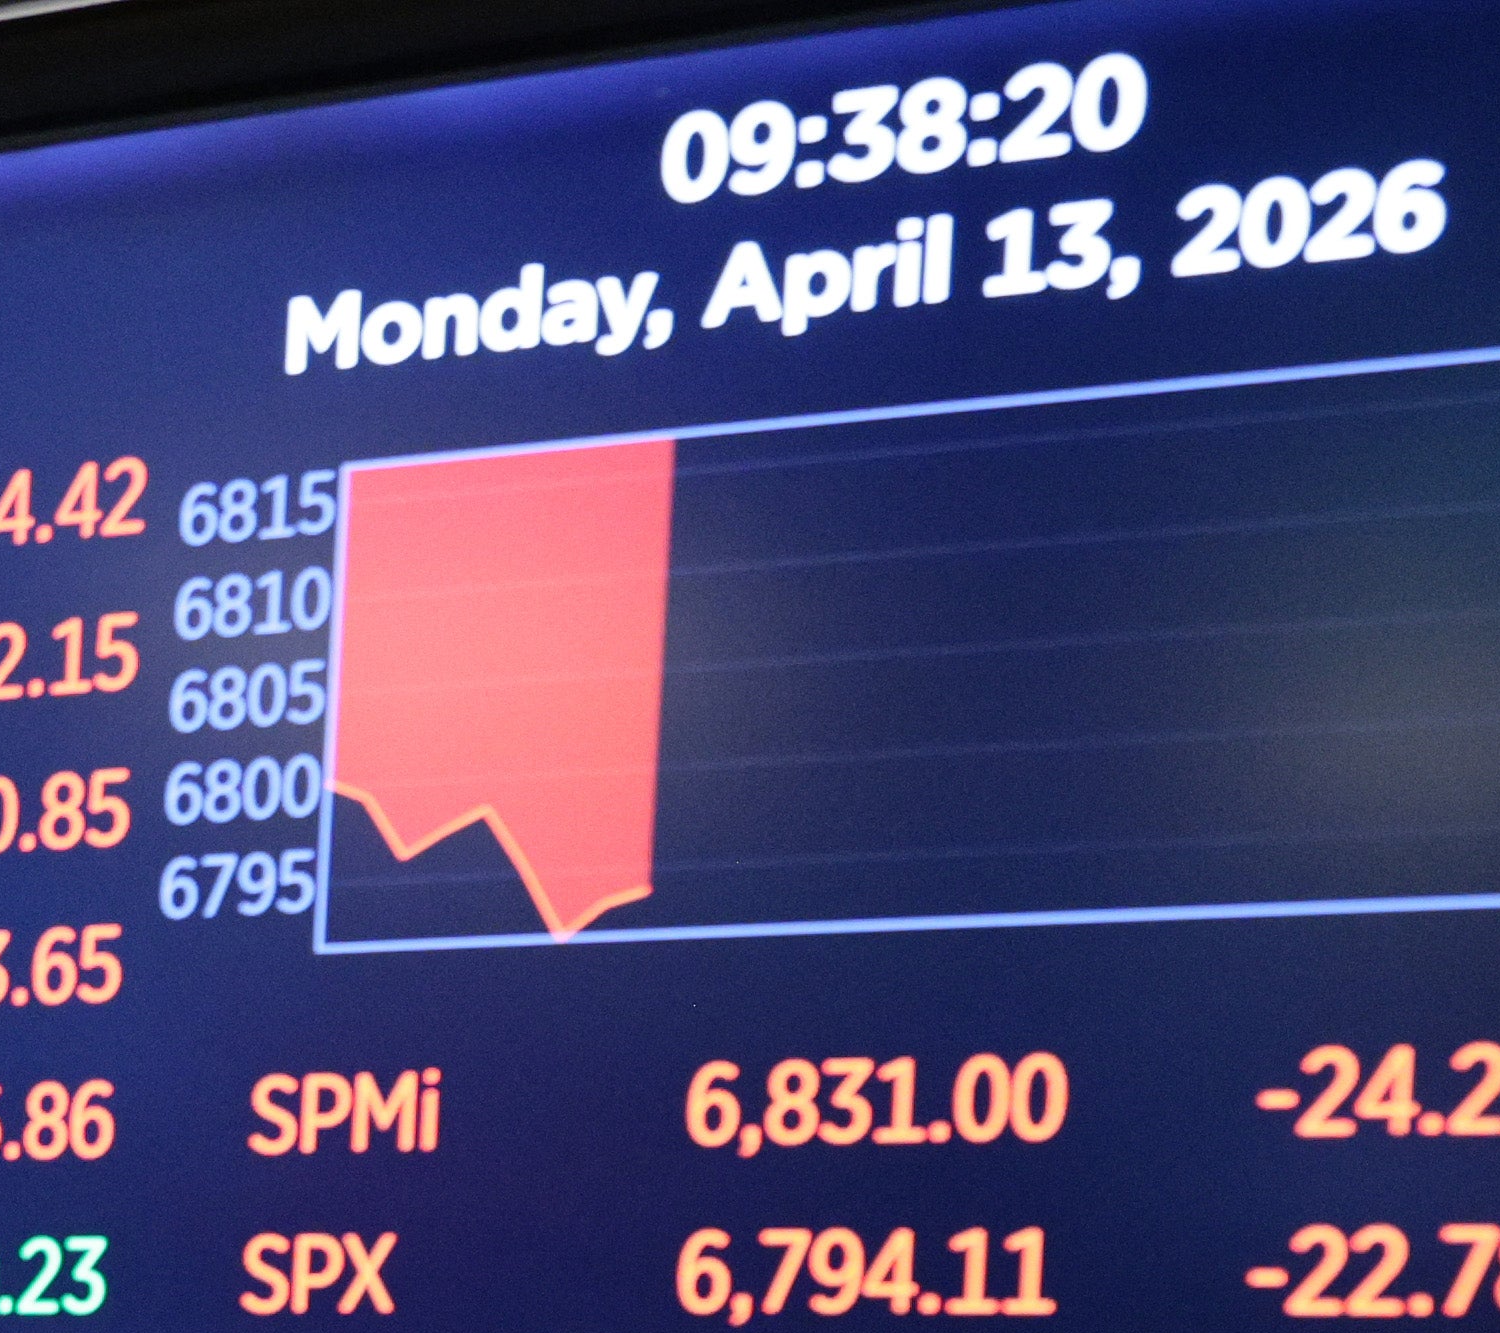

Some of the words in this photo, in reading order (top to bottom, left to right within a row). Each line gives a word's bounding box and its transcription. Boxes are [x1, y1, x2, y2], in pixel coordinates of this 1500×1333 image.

[660, 51, 1150, 204] 09:38:20
[281, 262, 675, 376] Monday,
[702, 215, 951, 338] April
[983, 200, 1140, 300] 13,
[1170, 158, 1449, 279] 2026
[179, 469, 337, 546] 6815
[174, 565, 332, 641] 6810
[169, 658, 327, 733] 6805
[164, 753, 322, 826] 6800
[159, 848, 317, 920] 6795
[686, 1052, 1068, 1158] 6,831.00
[240, 1232, 397, 1315] SPX
[676, 1227, 1056, 1326] 6,794.11
